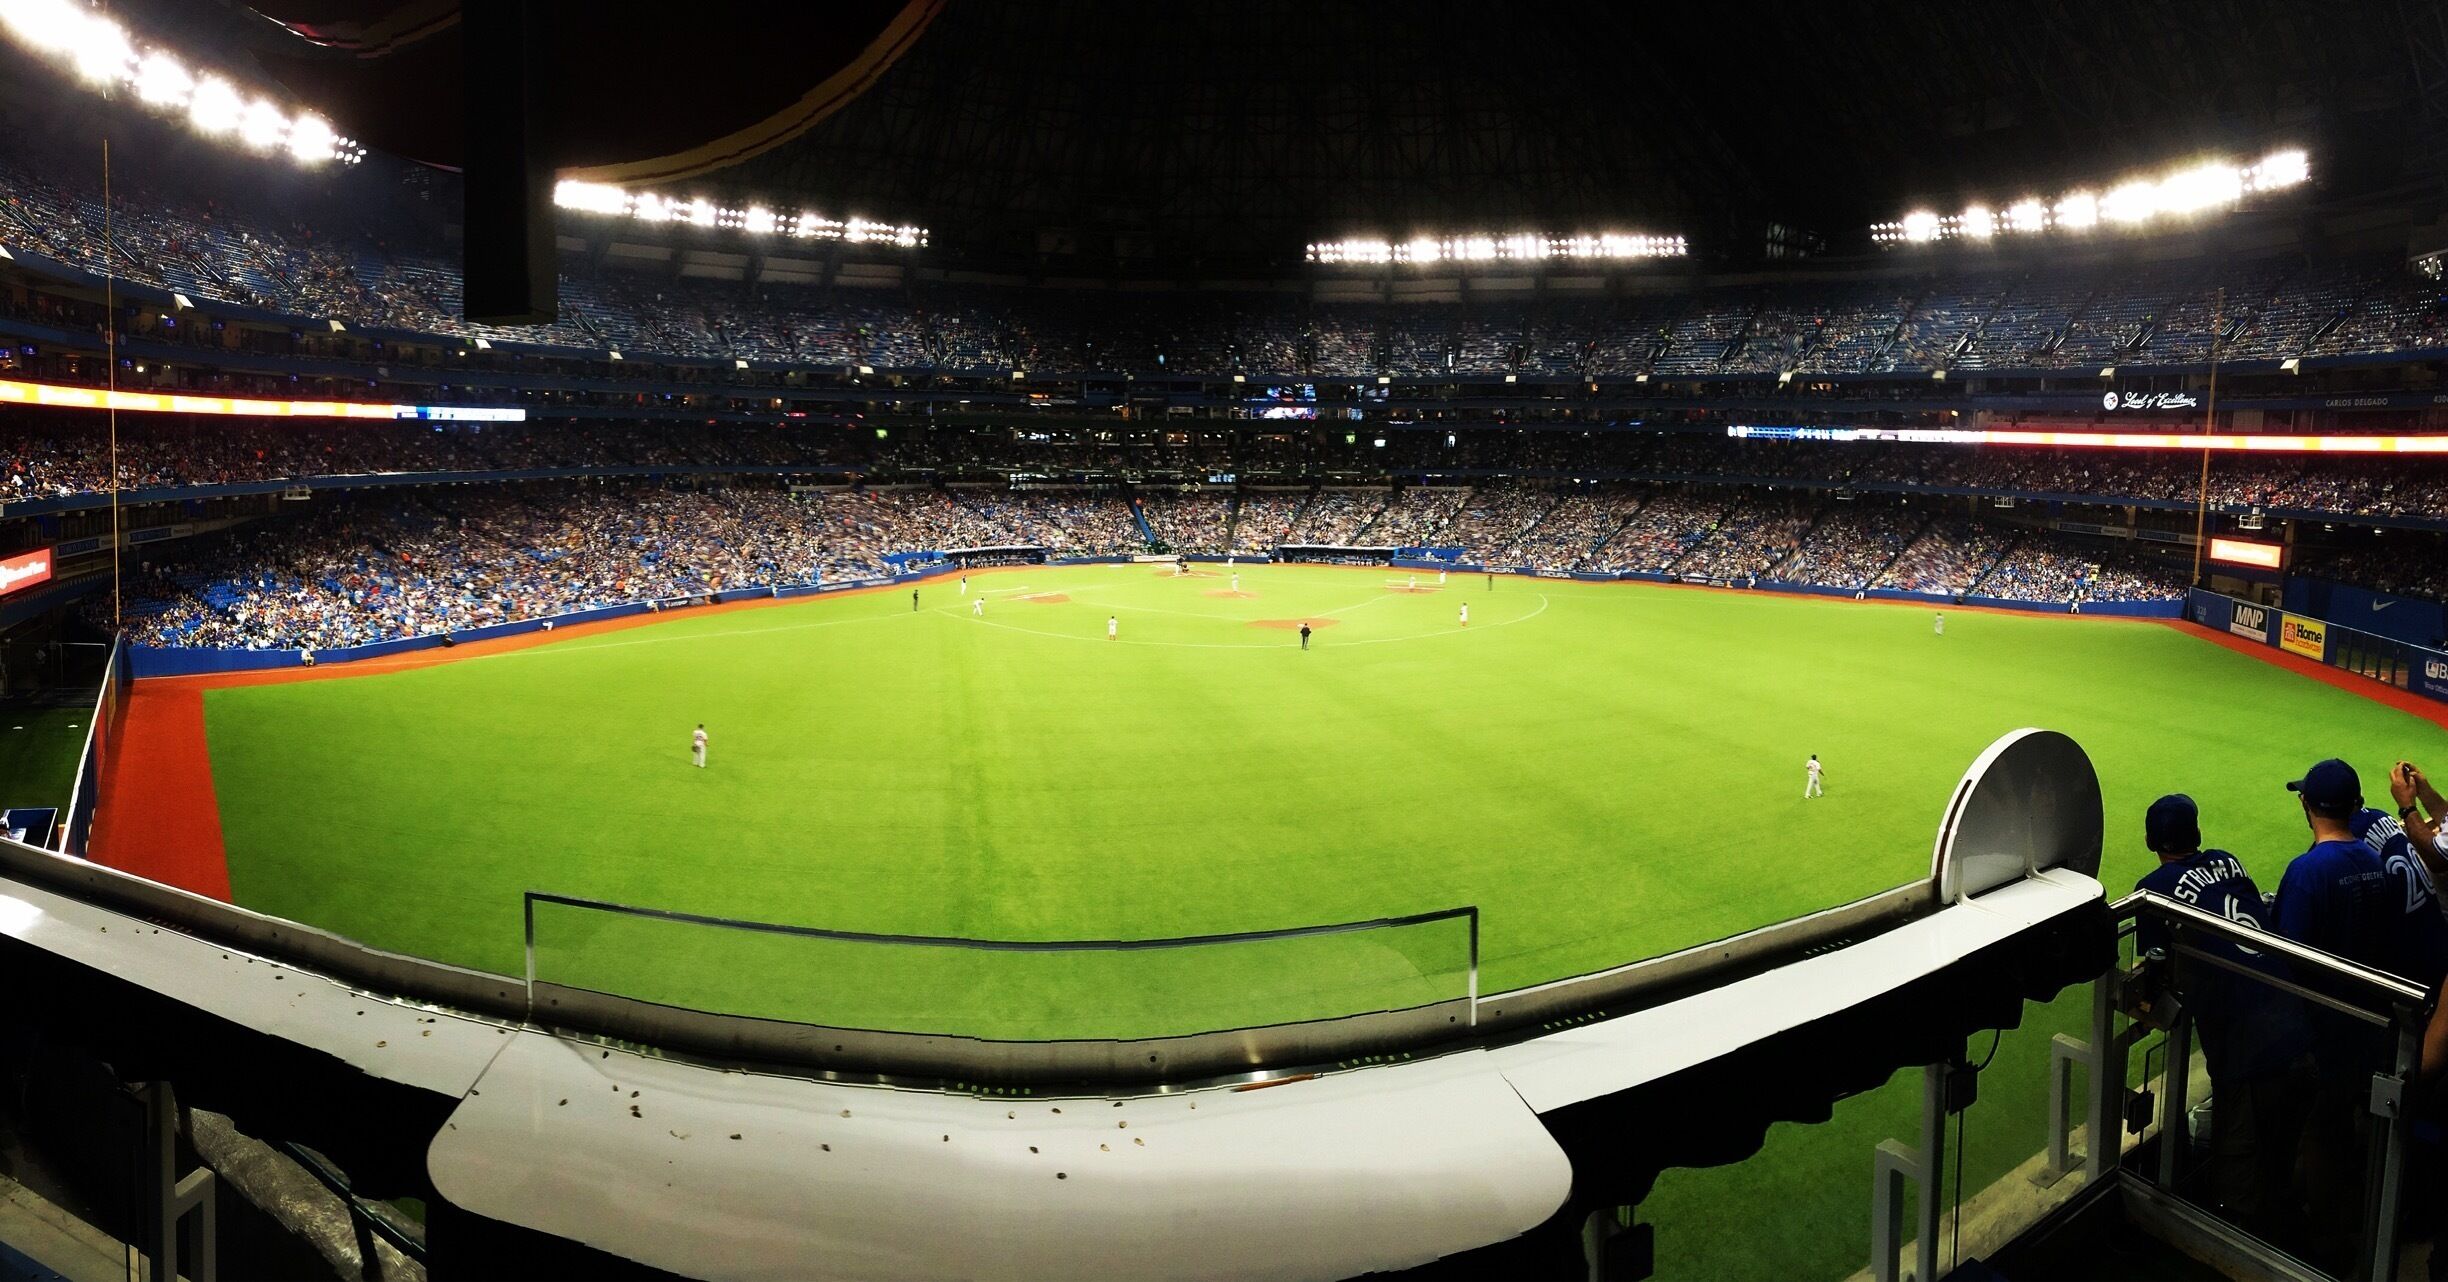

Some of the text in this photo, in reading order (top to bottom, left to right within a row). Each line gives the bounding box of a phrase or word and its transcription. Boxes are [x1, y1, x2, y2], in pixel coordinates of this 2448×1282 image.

[2146, 396, 2158, 409] of
[2156, 392, 2197, 409] Excellence
[2325, 397, 2389, 407] CARLOS DELGADO
[2235, 605, 2264, 629] MNP
[2296, 623, 2323, 643] Home
[2386, 843, 2438, 914] 20
[2224, 893, 2263, 955] 6
